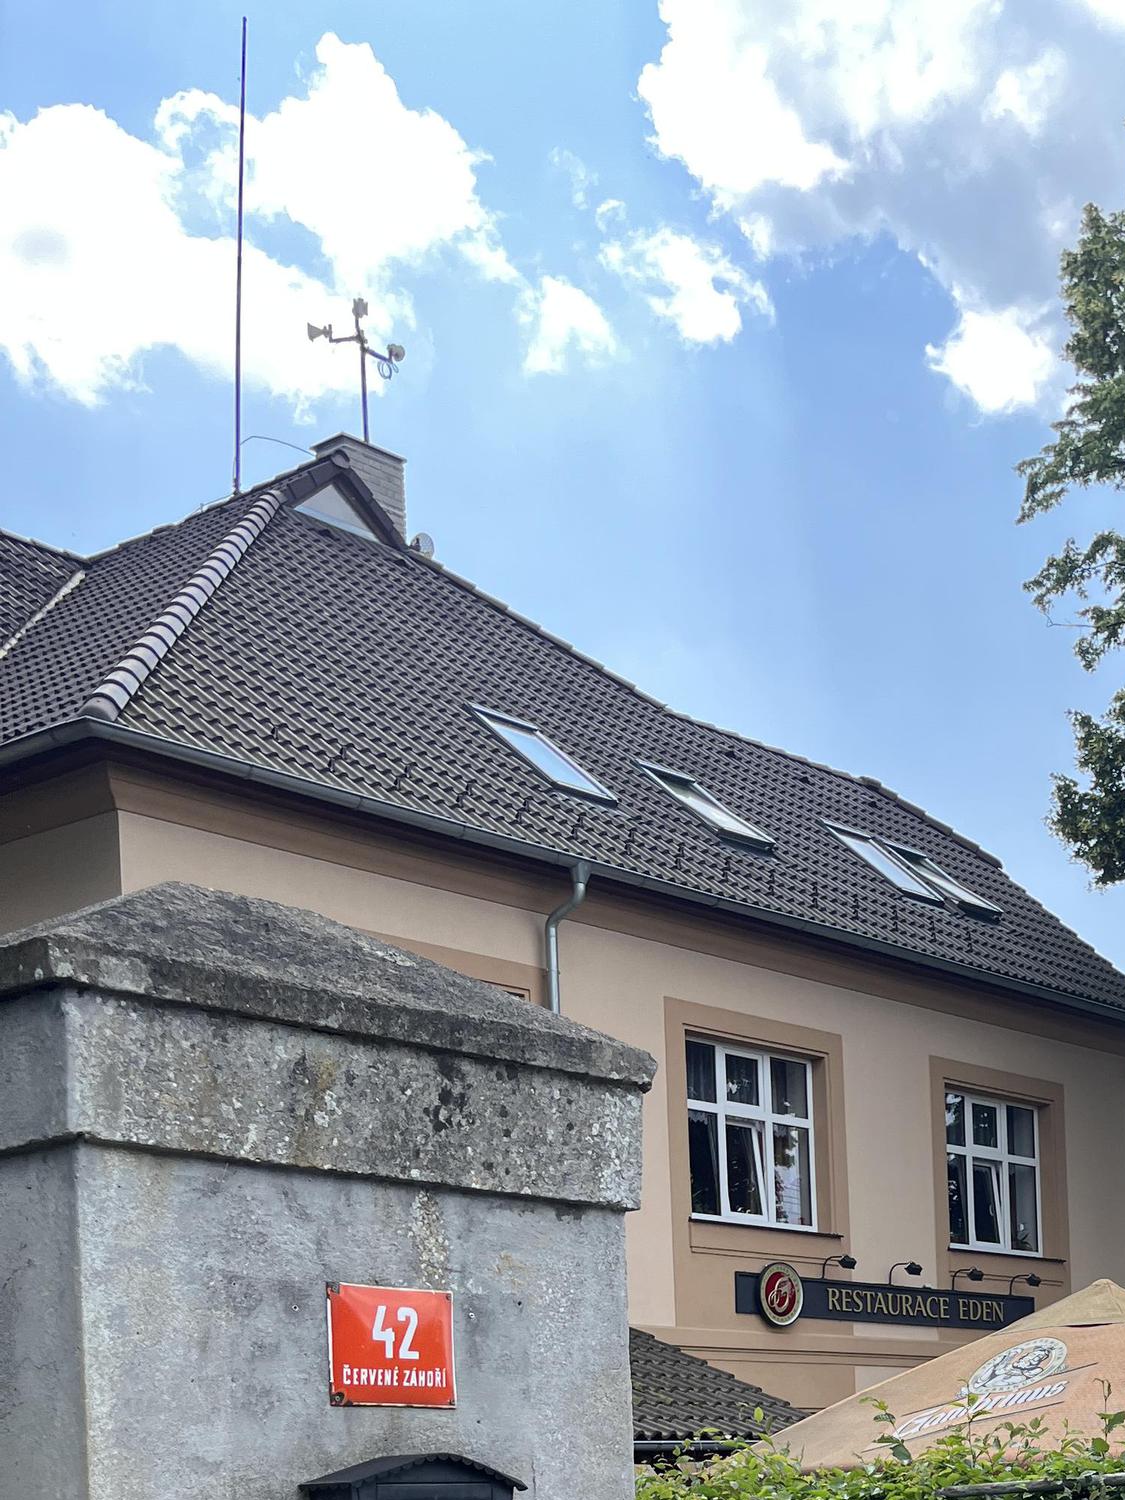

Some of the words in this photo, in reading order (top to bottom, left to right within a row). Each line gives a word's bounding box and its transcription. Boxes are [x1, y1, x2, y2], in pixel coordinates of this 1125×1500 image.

[827, 1287, 950, 1319] RESTAURACE
[958, 1299, 1004, 1322] EDEN
[372, 1305, 419, 1360] 42
[343, 1364, 398, 1386] ČERVENÉ
[403, 1367, 446, 1388] ZÁHOŘÍ
